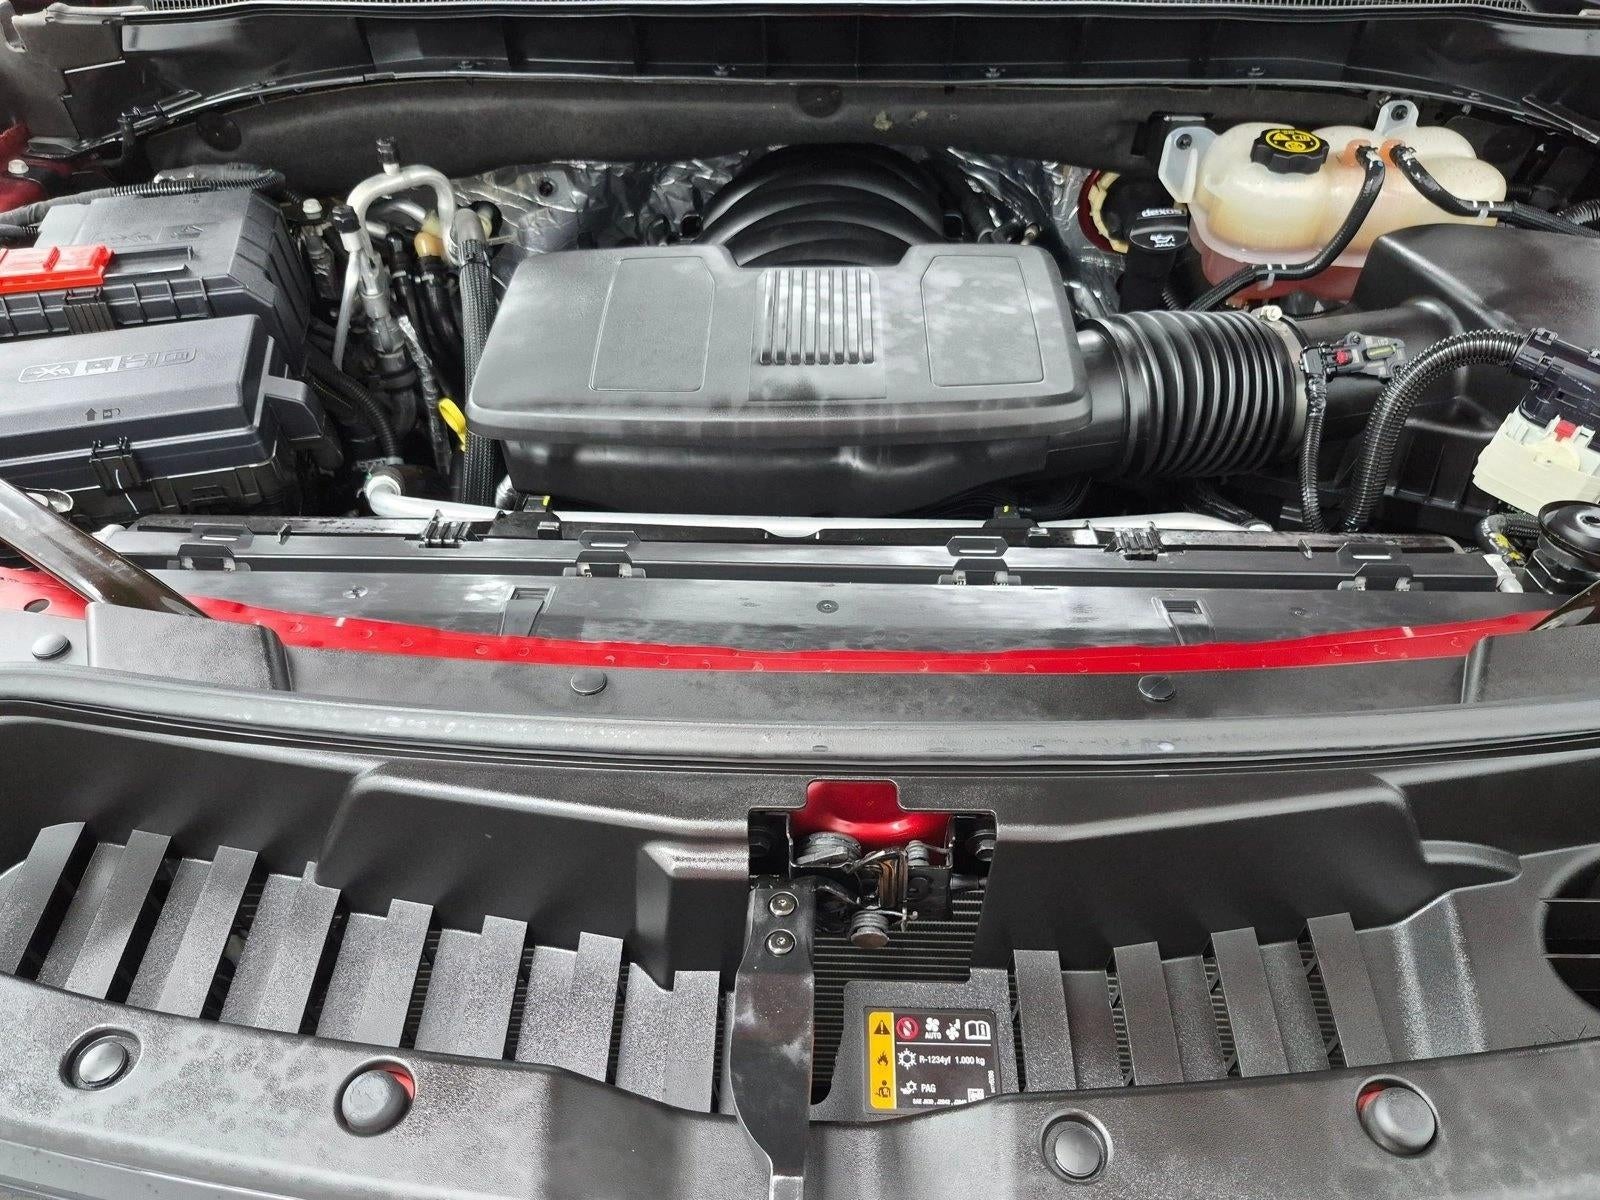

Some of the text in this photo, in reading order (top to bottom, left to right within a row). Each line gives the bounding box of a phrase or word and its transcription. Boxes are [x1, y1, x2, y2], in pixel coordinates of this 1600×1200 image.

[1142, 208, 1182, 218] dexos
[925, 1032, 942, 1040] AUTO
[919, 1055, 986, 1067] R-1234yf 1.000 kg
[921, 1083, 937, 1093] PAG
